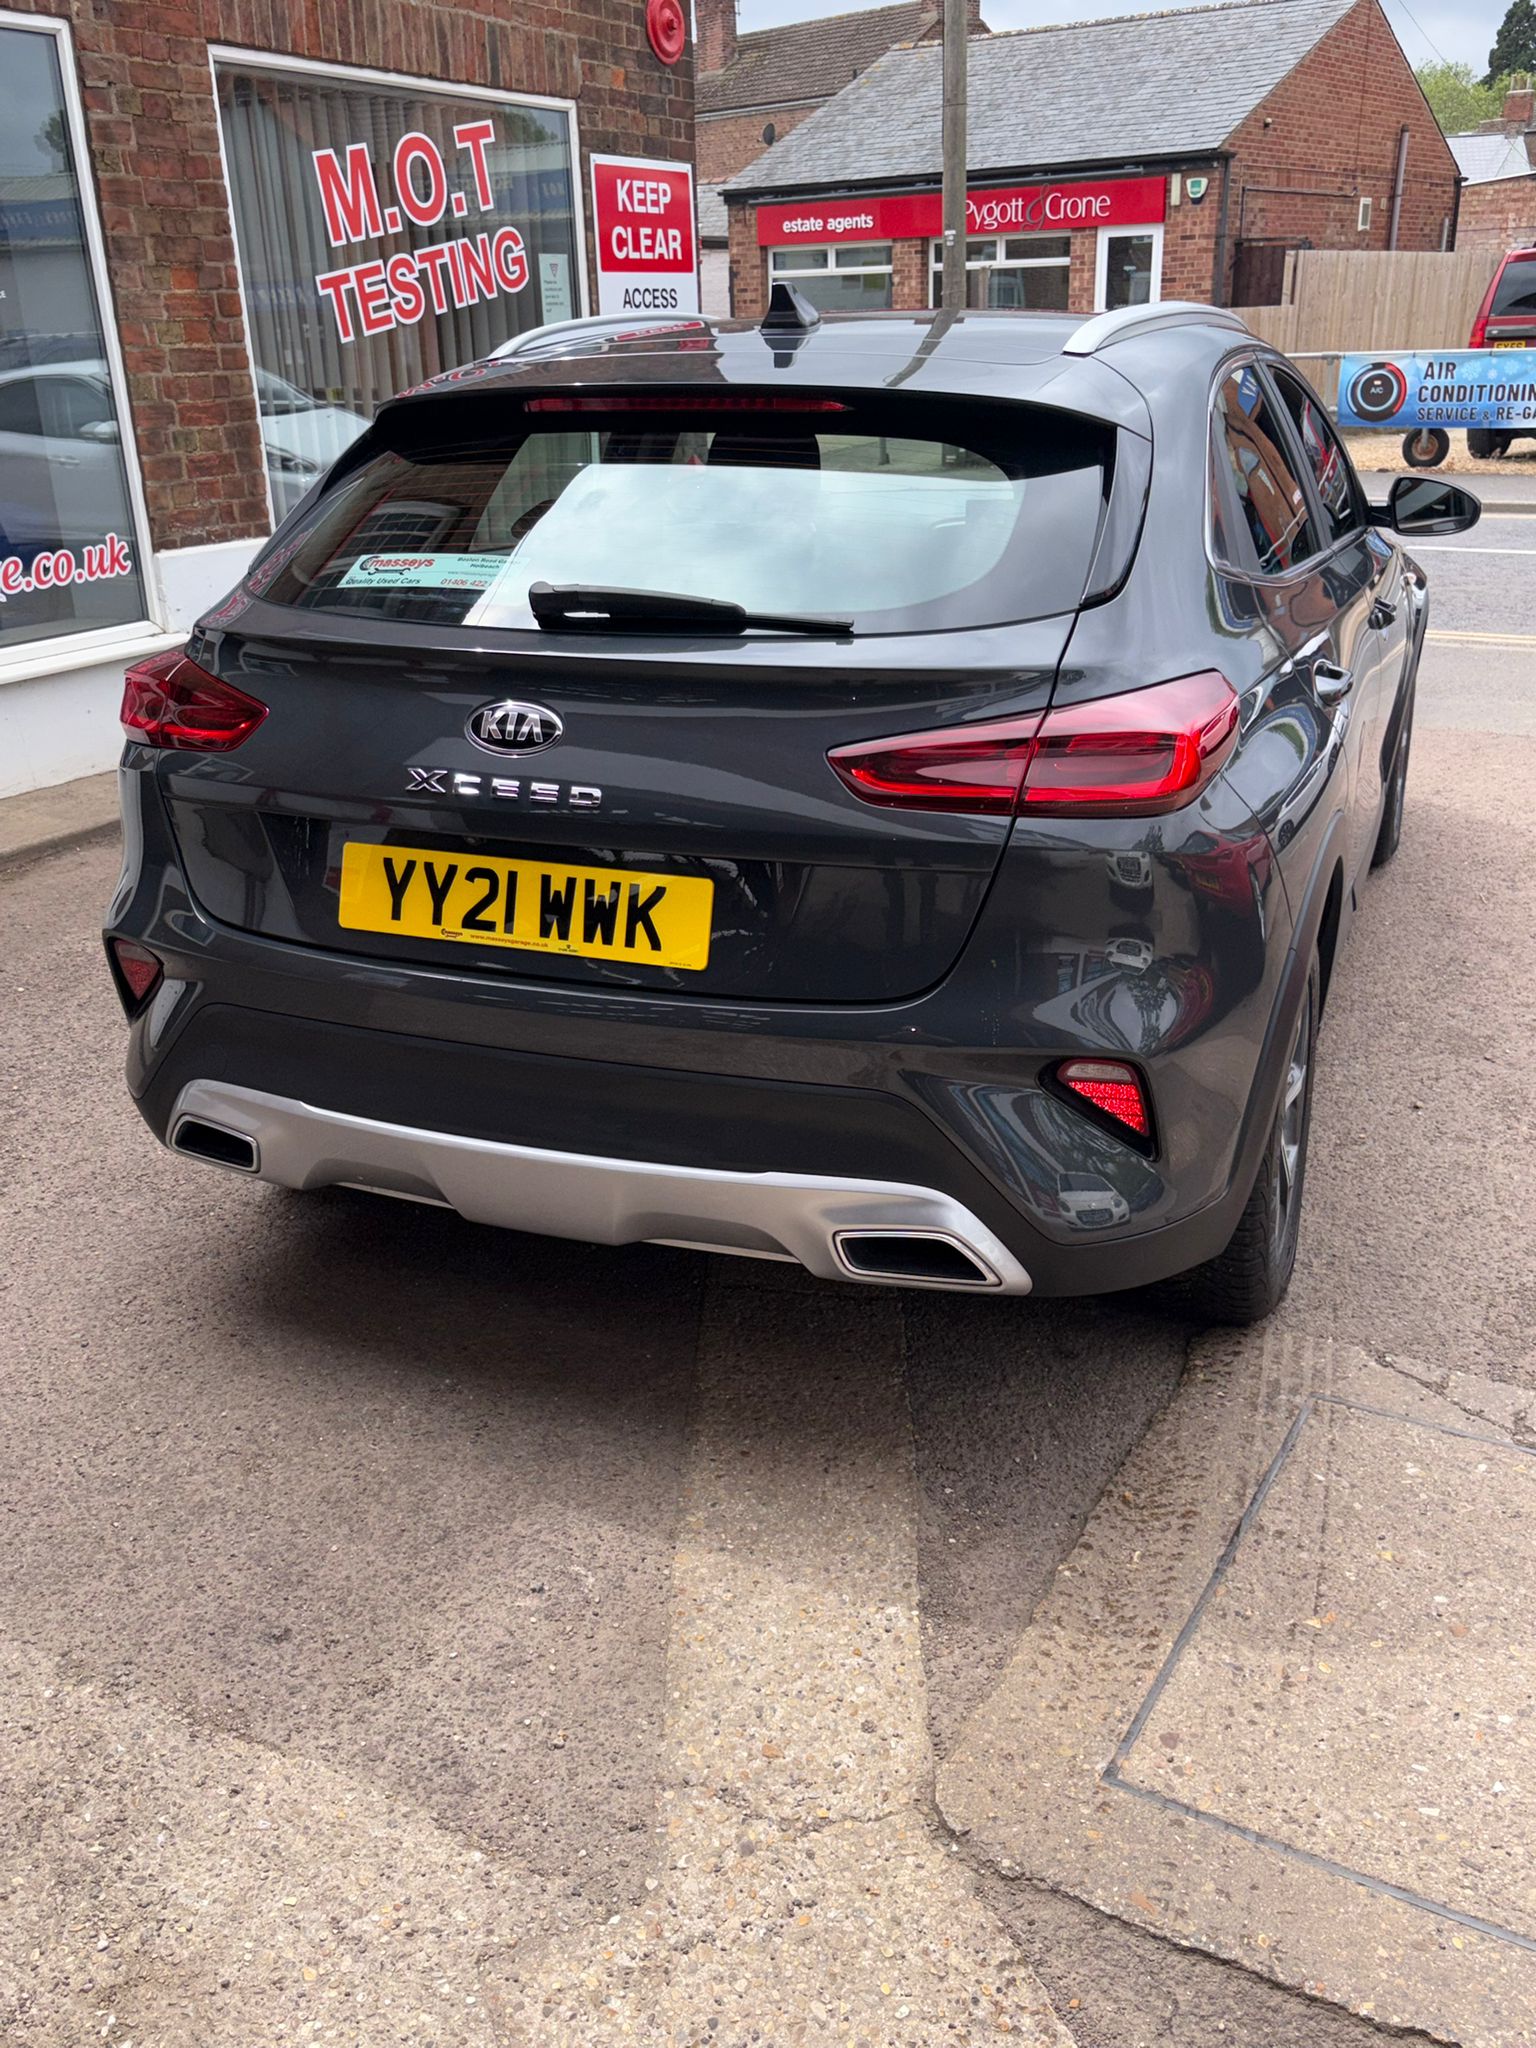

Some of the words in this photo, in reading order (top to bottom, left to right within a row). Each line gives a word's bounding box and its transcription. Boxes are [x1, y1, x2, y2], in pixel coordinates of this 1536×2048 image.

[312, 119, 495, 247] M.O.T
[617, 179, 671, 214] KEEP
[783, 217, 823, 232] estate
[827, 213, 873, 232] agents
[1045, 193, 1111, 219] Crone
[611, 225, 682, 260] CLEAR
[315, 226, 529, 343] TESTING
[623, 288, 678, 309] ACCESS
[1424, 362, 1457, 380] AIR
[1417, 407, 1477, 421] SERVICE
[1482, 410, 1489, 420] &
[0, 532, 131, 602] e.co.uk
[369, 558, 435, 569] masseys
[480, 711, 543, 742] KIA
[405, 768, 603, 807] XCEED
[383, 857, 518, 935] YY21
[539, 873, 667, 952] WWK
